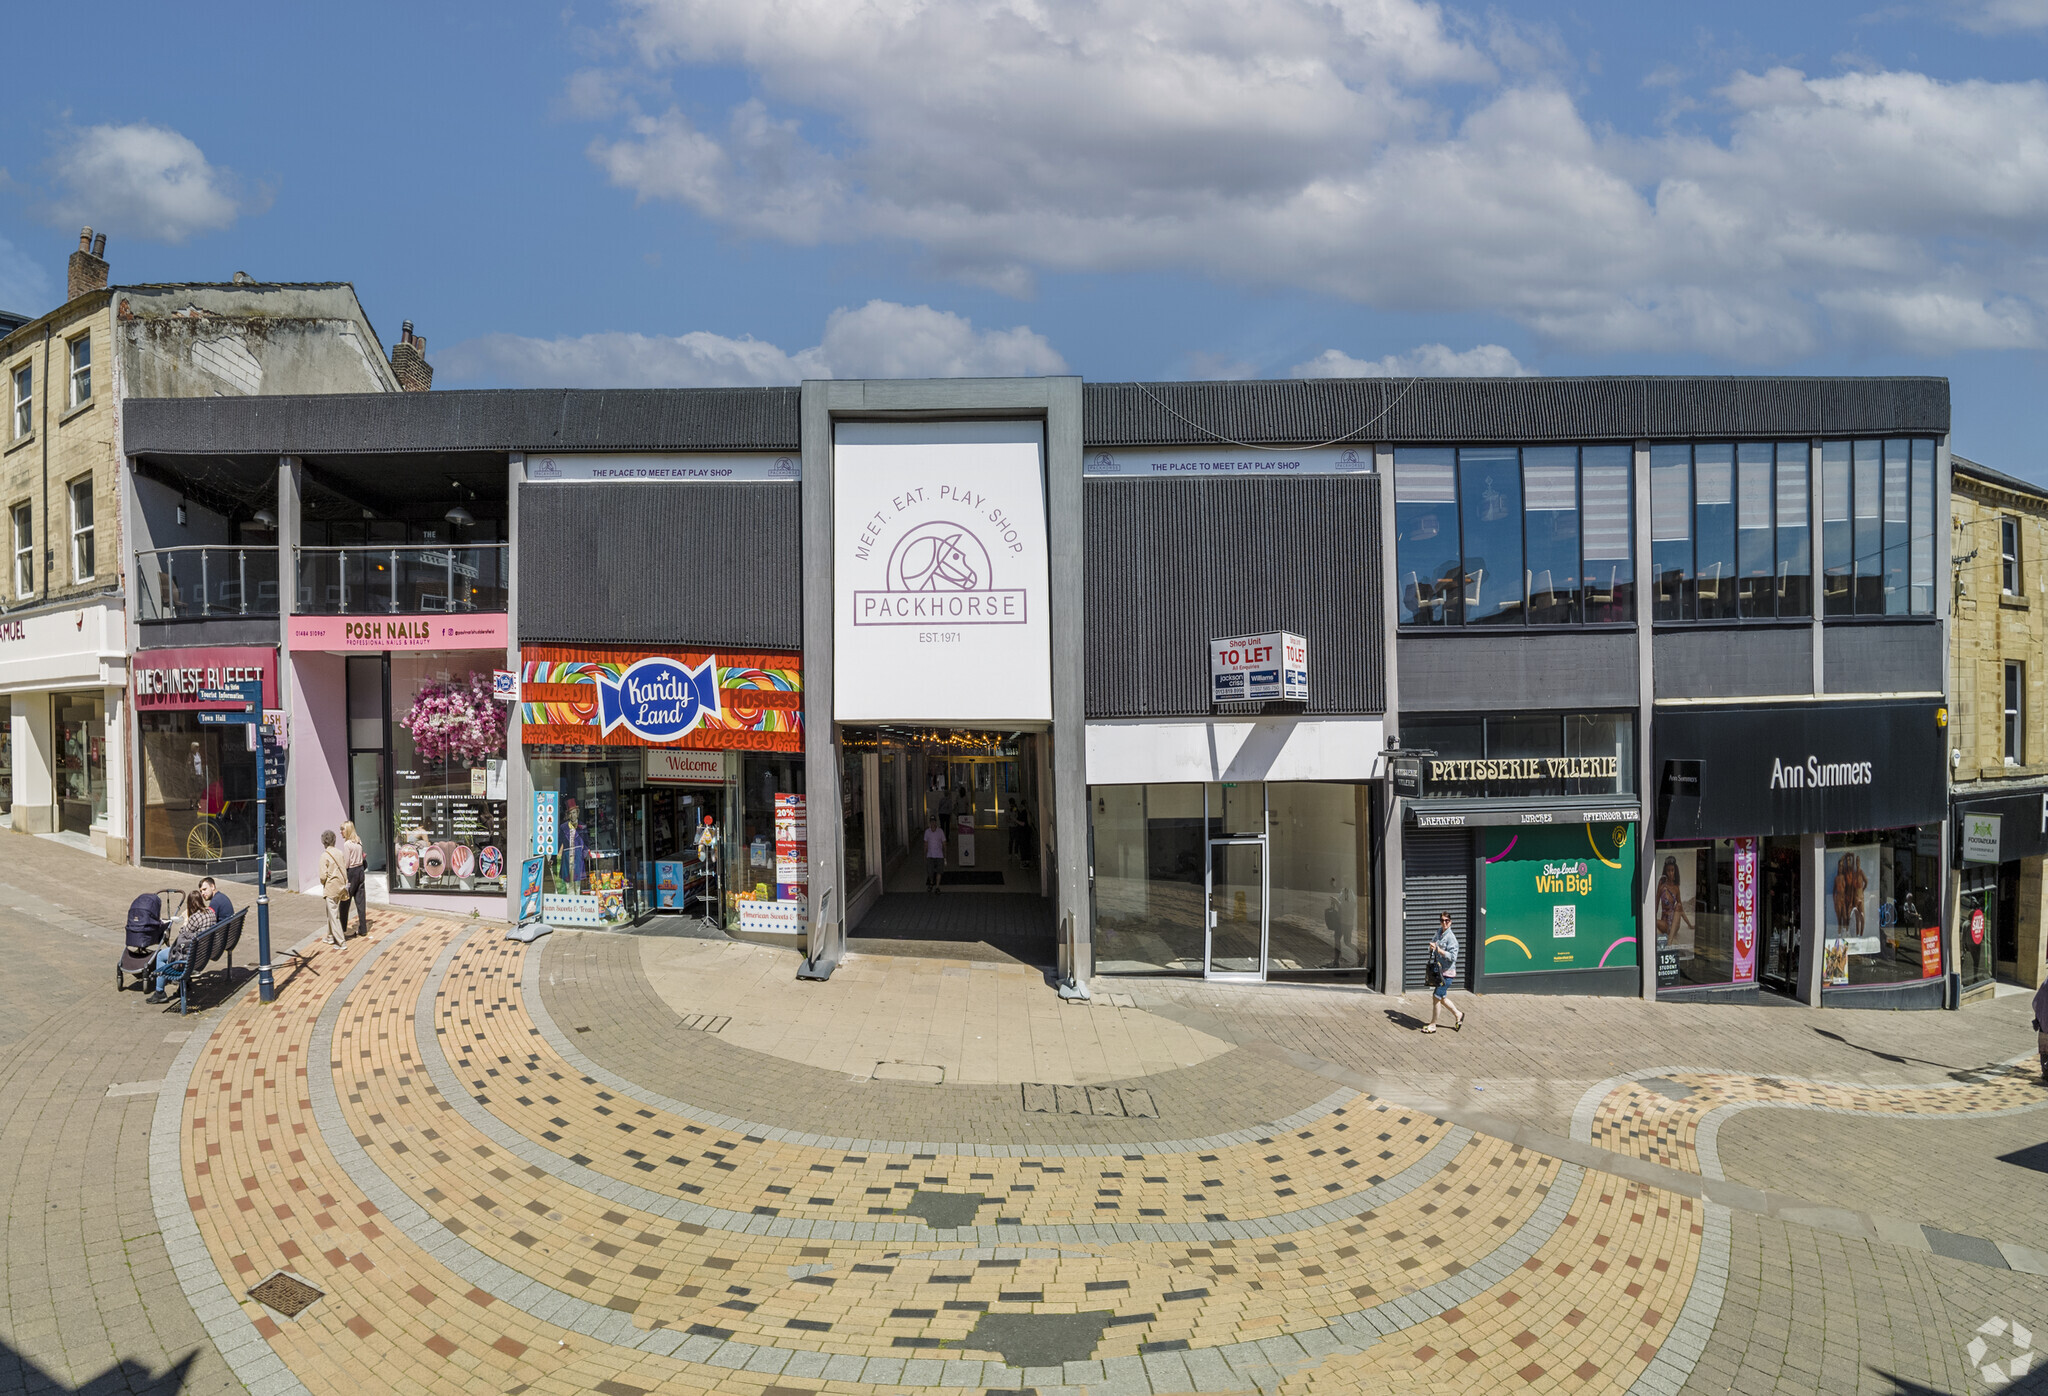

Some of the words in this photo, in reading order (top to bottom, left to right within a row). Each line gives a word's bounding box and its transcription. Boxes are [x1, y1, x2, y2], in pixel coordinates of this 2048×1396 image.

[672, 469, 687, 477] EAT
[1151, 463, 1168, 471] THE
[1170, 463, 1197, 471] PLACE
[1200, 463, 1211, 471] TO
[1255, 462, 1276, 470] PLAY
[1277, 462, 1300, 470] SHOP
[855, 511, 892, 561] MEET.
[892, 487, 930, 512] EAT.
[940, 485, 986, 514] PLAY.
[988, 508, 1023, 559] SHOP.
[865, 596, 1015, 617] PACKHORSE
[346, 622, 381, 639] POSH
[387, 621, 430, 639] NAILS
[919, 632, 961, 643] EST.1971
[1229, 640, 1246, 648] Shop
[1219, 650, 1240, 665] TO
[1245, 646, 1273, 663] LET
[1286, 646, 1294, 661] TO
[1295, 649, 1305, 663] LET
[153, 668, 203, 694] CHINESE
[1219, 674, 1244, 682] jackson
[200, 691, 217, 699] Tourist
[218, 692, 244, 700] Information
[628, 675, 694, 708] Kandy
[730, 689, 798, 709] Hostess
[201, 714, 214, 722] Town
[215, 714, 226, 722] Hall
[263, 714, 281, 724] OSH
[635, 701, 684, 726] Land
[666, 756, 718, 772] Welcome
[1430, 759, 1541, 781] PATISSERIE
[1545, 756, 1617, 778] VALERIE
[1678, 774, 1697, 782] Summers
[1770, 758, 1804, 790] Ann
[1807, 755, 1872, 788] Summers
[776, 808, 794, 818] 20%
[1521, 814, 1552, 824] LUNCHES
[1583, 812, 1622, 821] AFTERNOON
[1622, 811, 1638, 820] TEAS
[1738, 848, 1744, 860] IS
[1543, 864, 1560, 878] Shop
[1536, 876, 1564, 893] Win
[1566, 874, 1592, 896] Big!
[743, 911, 769, 919] American
[770, 912, 788, 920] Sweets
[1972, 918, 1983, 930] SALE
[1660, 954, 1676, 964] 15%
